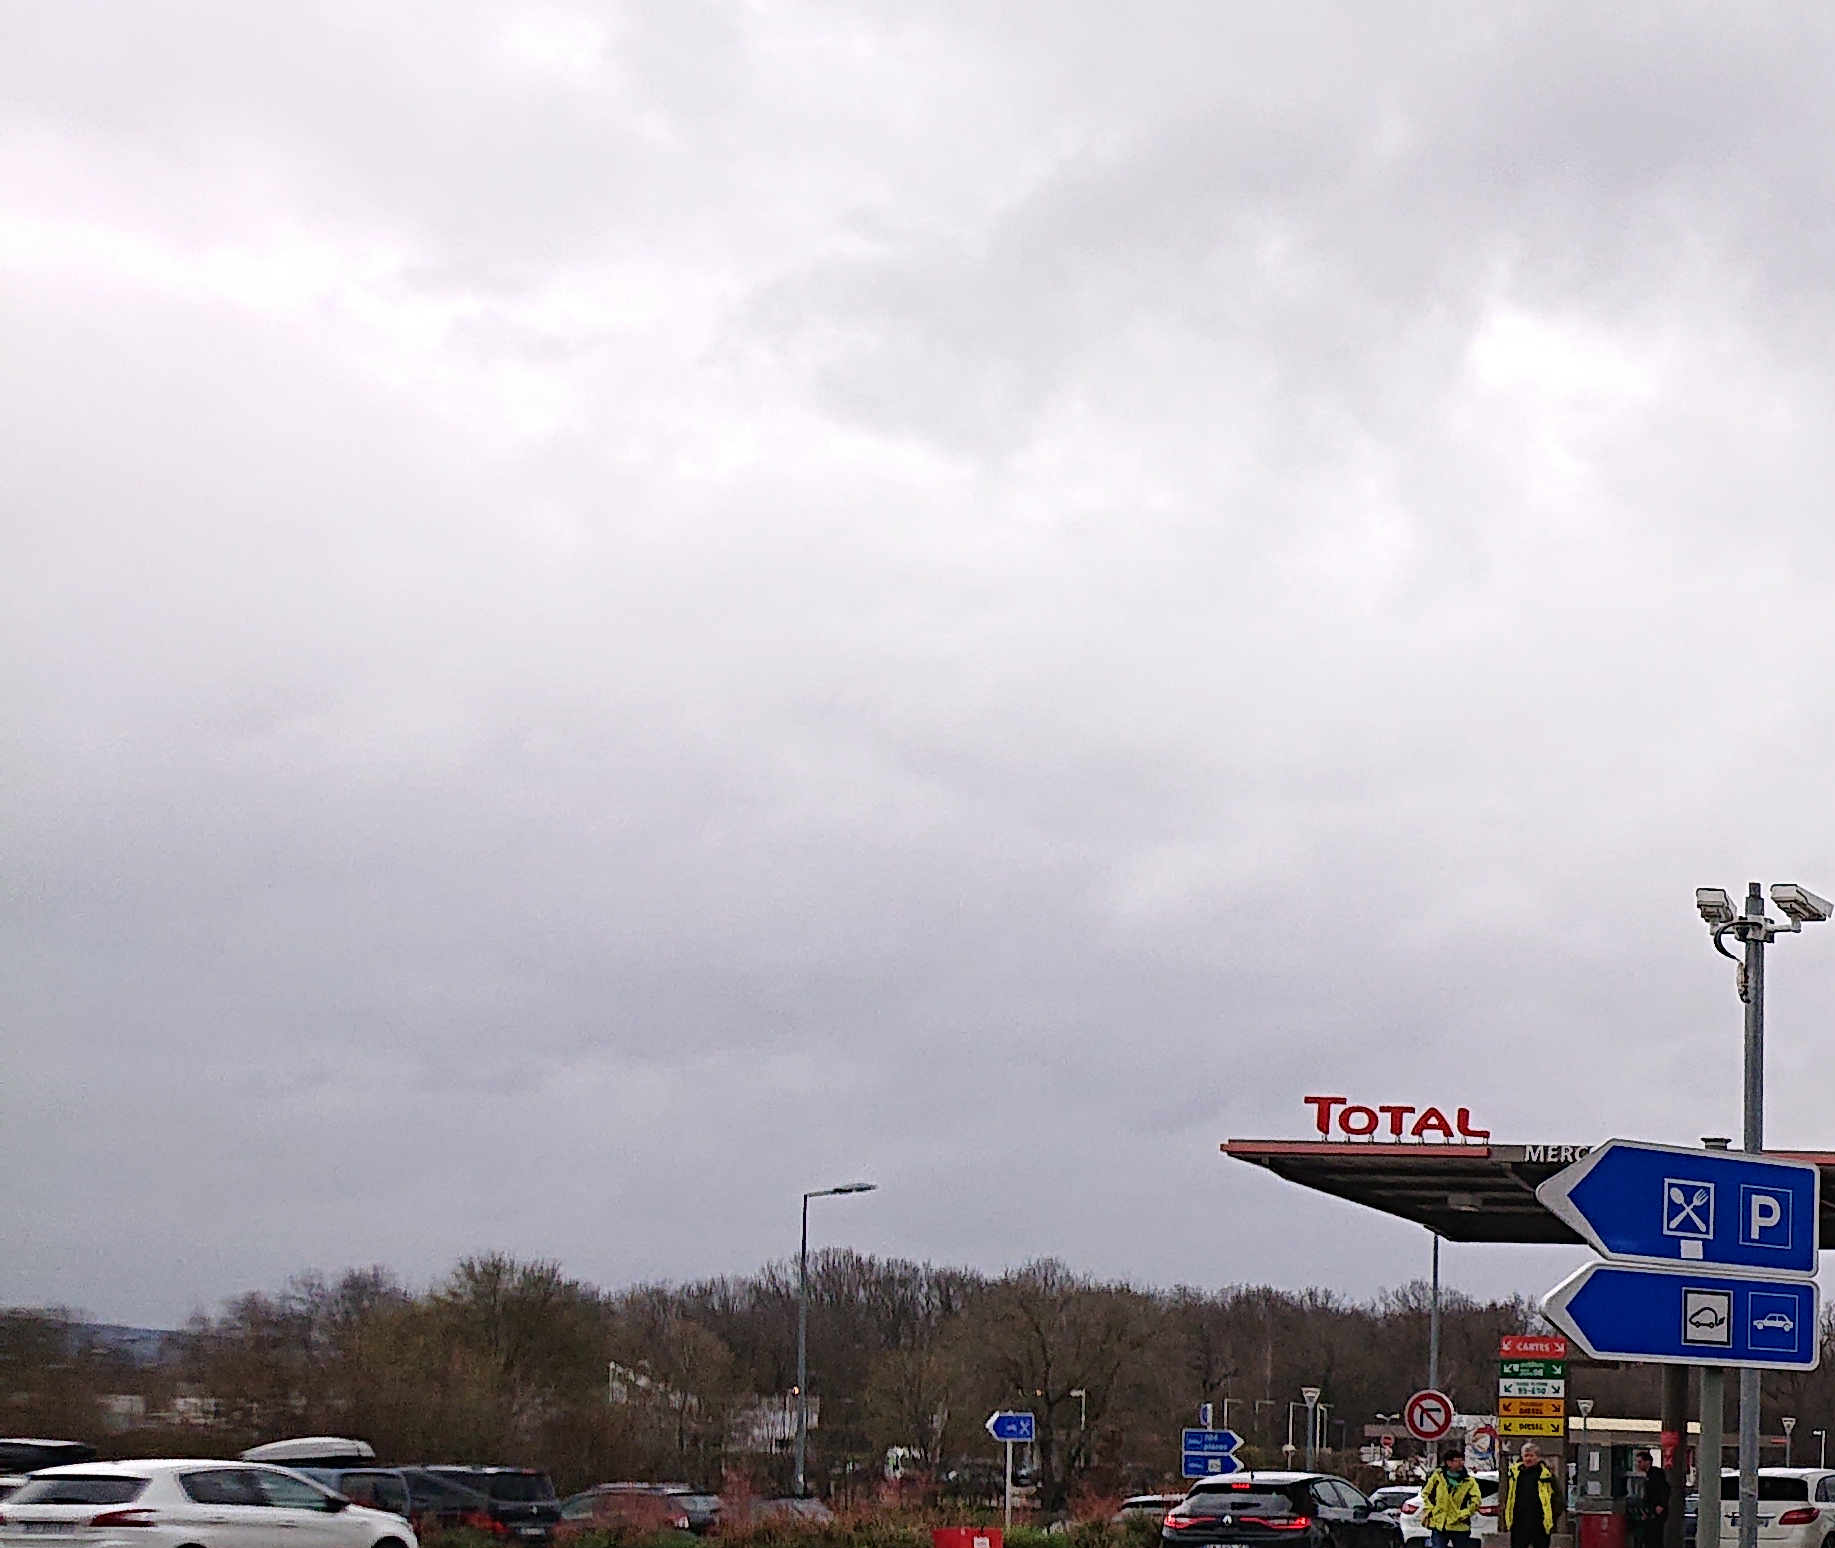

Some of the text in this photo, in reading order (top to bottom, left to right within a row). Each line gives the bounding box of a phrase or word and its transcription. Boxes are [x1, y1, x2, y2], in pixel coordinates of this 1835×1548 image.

[1304, 1096, 1491, 1138] TOTAL
[1751, 1194, 1781, 1240] P
[1517, 1343, 1549, 1352] CARTES
